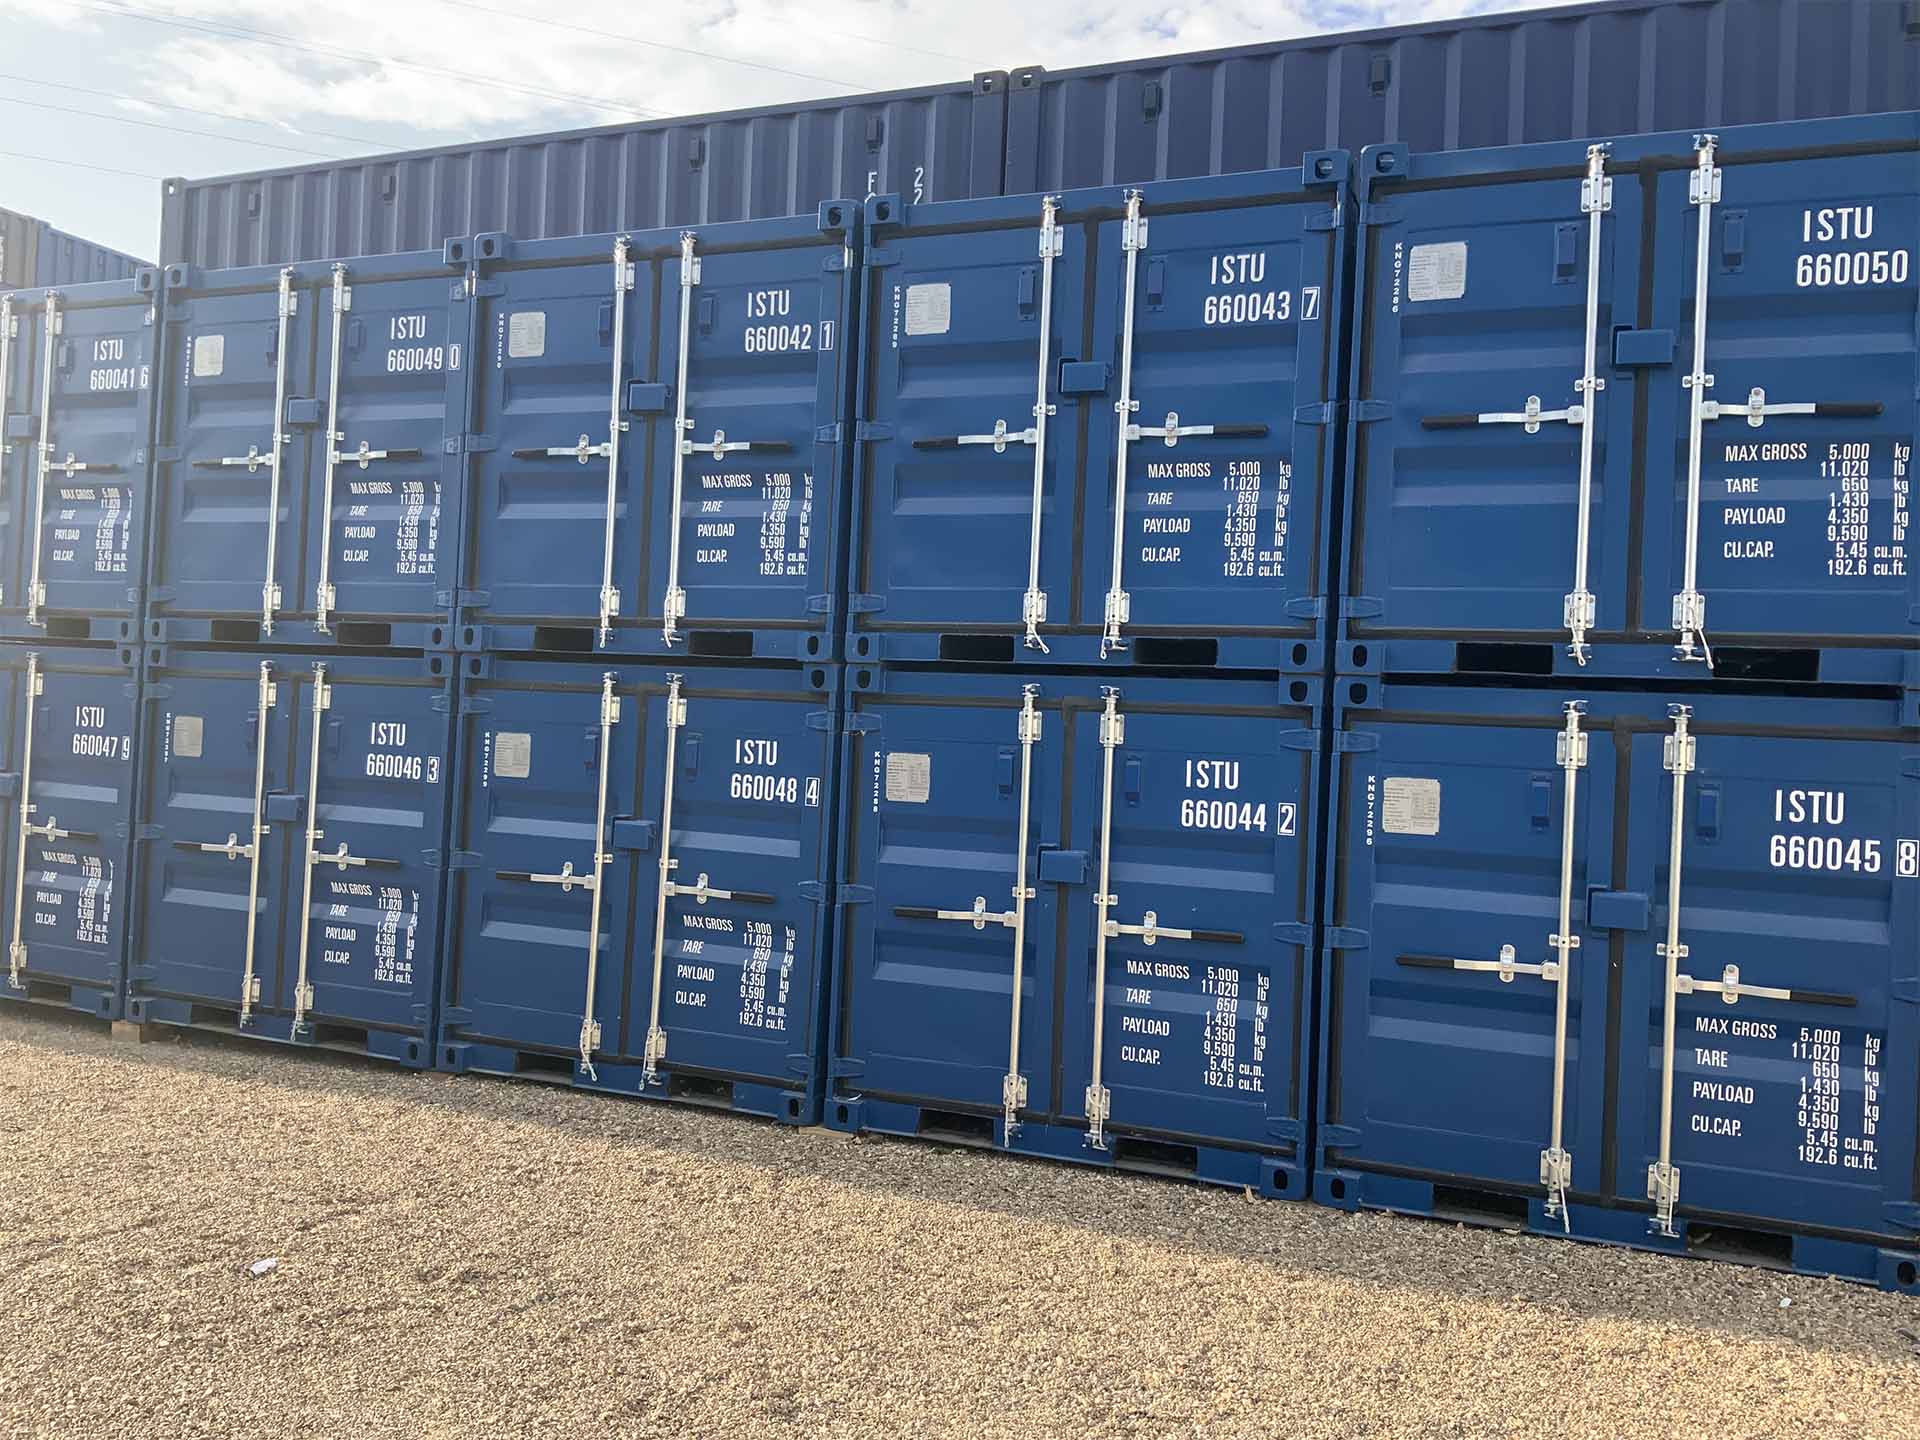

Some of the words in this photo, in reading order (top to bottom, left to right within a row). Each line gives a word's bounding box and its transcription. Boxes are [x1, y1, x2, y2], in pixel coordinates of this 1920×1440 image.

[1803, 205, 1873, 242] ISTU
[1211, 253, 1265, 285] ISTU
[1392, 243, 1403, 312] KNG72286
[1796, 249, 1909, 287] 660050
[747, 289, 790, 318] ISTU
[1204, 291, 1291, 325] 660043
[1302, 288, 1319, 319] 7
[390, 315, 426, 340] ISTU
[745, 324, 812, 353] 660042
[821, 322, 833, 349] 1
[94, 338, 123, 361] ISTU
[387, 346, 443, 372] 660049
[450, 345, 460, 370] 0
[90, 367, 135, 390] 660041
[140, 367, 149, 388] 6
[1725, 445, 1758, 462] MAX
[1762, 443, 1807, 461] GROSS
[1895, 443, 1910, 460] kg
[1148, 463, 1173, 478] MAX
[1176, 463, 1211, 478] GROSS
[1280, 461, 1291, 478] kg
[1894, 461, 1905, 475] lb
[1279, 477, 1288, 490] lb
[1725, 478, 1759, 492] TARE
[1842, 478, 1868, 492] 650
[1894, 477, 1909, 493] kg
[1147, 492, 1173, 505] TARE
[1238, 491, 1259, 503] 650
[1278, 491, 1289, 505] kg
[1894, 493, 1905, 508] lb
[1276, 505, 1285, 518] lb
[1724, 507, 1785, 525] PAYLOAD
[1894, 509, 1908, 527] kg
[1144, 518, 1190, 533] PAYLOAD
[1275, 519, 1287, 534] kg
[1893, 526, 1904, 541] lb
[1275, 533, 1283, 546] lb
[1724, 541, 1774, 558] CU.CAP.
[1836, 543, 1867, 558] 5.45
[1874, 546, 1907, 558] cu.m.
[1142, 548, 1180, 562] CU.CAP.
[1230, 548, 1254, 562] 5.45
[1259, 551, 1285, 562] cu.m.
[1224, 563, 1253, 576] 192.6
[1259, 563, 1284, 576] cu.ft.
[1828, 560, 1867, 575] 192.6
[1873, 560, 1906, 576] cu.ft.
[75, 706, 105, 728] ISTU
[72, 733, 118, 758] 660047
[121, 737, 130, 759] 9
[370, 722, 406, 746] ISTU
[735, 739, 778, 766] ISTU
[366, 753, 422, 780] 660046
[428, 758, 437, 782] 3
[1185, 759, 1239, 790] ISTU
[730, 773, 798, 803] 660048
[806, 778, 819, 805] 4
[1181, 799, 1267, 832] 660044
[1279, 804, 1295, 835] 2
[1367, 776, 1375, 845] KNG72296
[1775, 789, 1845, 825] ISTU
[1770, 834, 1881, 873] 660045
[1898, 840, 1917, 876] 8
[1127, 960, 1152, 975] MAX
[1155, 963, 1190, 979] GROSS
[1258, 973, 1269, 989] kg
[1126, 988, 1151, 1004] TARE
[1217, 998, 1237, 1013] 650
[1256, 1002, 1268, 1019] kg
[1257, 987, 1266, 1001] lb
[1123, 1017, 1169, 1036] PAYLOAD
[1255, 1032, 1266, 1049] kg
[1255, 1017, 1264, 1033] lb
[1696, 1017, 1728, 1034] MAX
[1732, 1021, 1777, 1039] GROSS
[1866, 1034, 1881, 1052] kg
[1122, 1046, 1160, 1065] CU.CAP.
[1210, 1056, 1234, 1072] 5.45
[1239, 1064, 1264, 1077] cu.m.
[1254, 1047, 1263, 1061] lb
[1865, 1050, 1876, 1066] lb
[1696, 1048, 1728, 1067] TARE
[1813, 1062, 1839, 1079] 650
[1864, 1067, 1879, 1086] kg
[1204, 1071, 1233, 1087] 192.6
[1239, 1078, 1264, 1092] cu.ft.
[1865, 1086, 1876, 1101] lb
[1693, 1081, 1754, 1104] PAYLOAD
[1864, 1101, 1879, 1121] kg
[1692, 1115, 1742, 1136] CU.CAP.
[1807, 1129, 1838, 1147] 5.45
[1844, 1138, 1878, 1152] cu.m.
[1864, 1118, 1875, 1135] lb
[1799, 1146, 1837, 1165] 192.6
[1844, 1154, 1878, 1170] cu.ft.
